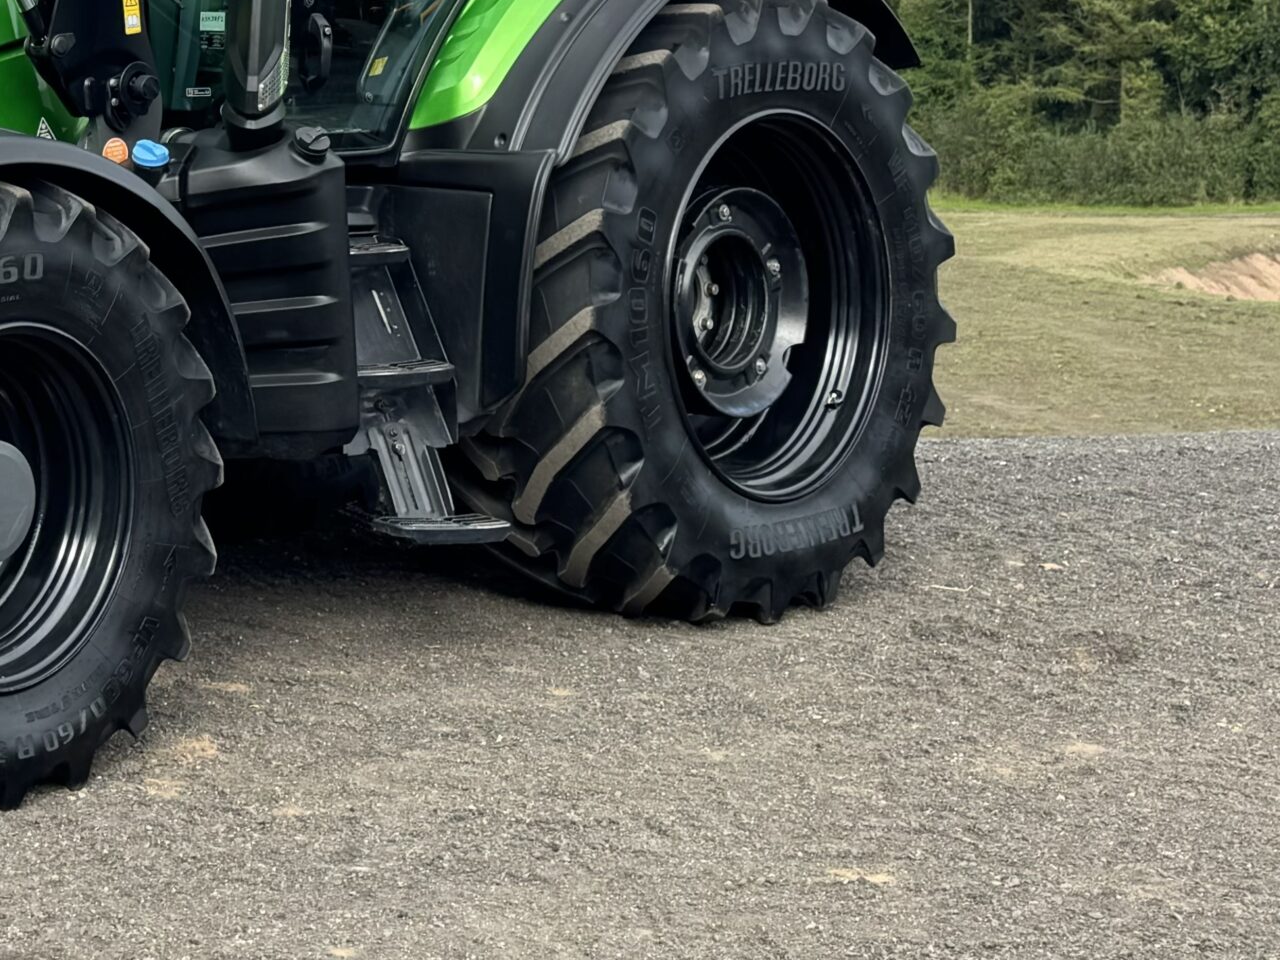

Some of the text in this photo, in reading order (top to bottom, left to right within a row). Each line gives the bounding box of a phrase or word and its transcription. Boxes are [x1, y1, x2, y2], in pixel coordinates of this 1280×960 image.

[711, 60, 846, 100] TRELLEBORG
[129, 312, 190, 517] TRELLEBORG
[729, 503, 864, 560] TRELLEBORG
